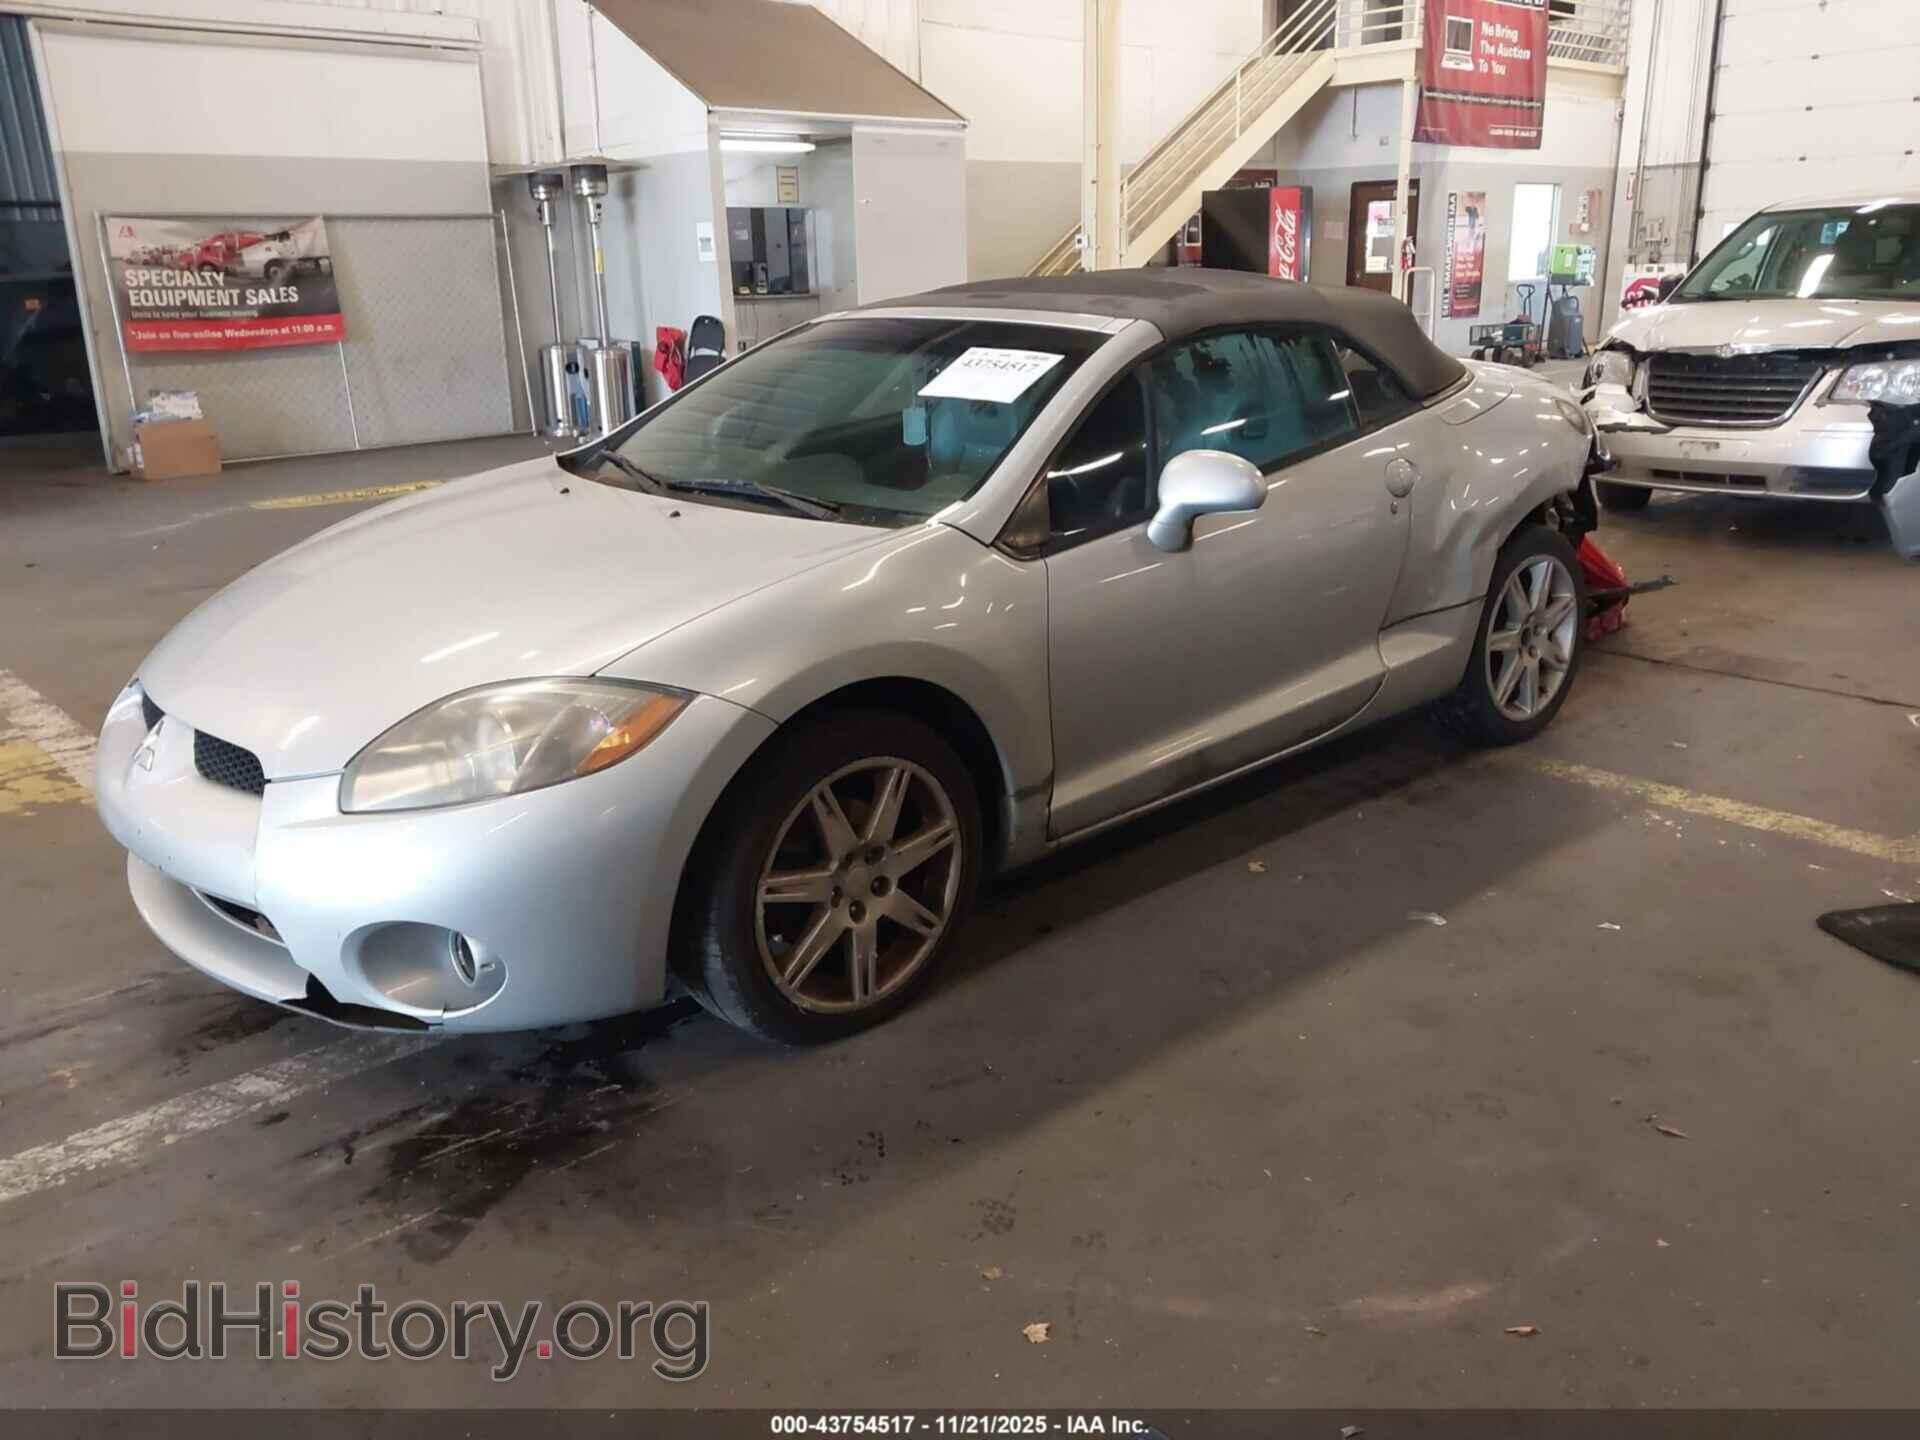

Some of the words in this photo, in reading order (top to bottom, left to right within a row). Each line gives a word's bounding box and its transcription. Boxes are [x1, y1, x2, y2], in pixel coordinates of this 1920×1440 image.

[1495, 23, 1519, 43] Bring
[1480, 40, 1495, 55] The
[1497, 43, 1531, 60] Auction
[1478, 58, 1488, 73] To
[1491, 60, 1506, 76] You
[125, 269, 224, 287] SPECIALTY
[128, 288, 240, 307] EQUIPMENT
[246, 286, 299, 305] SALES
